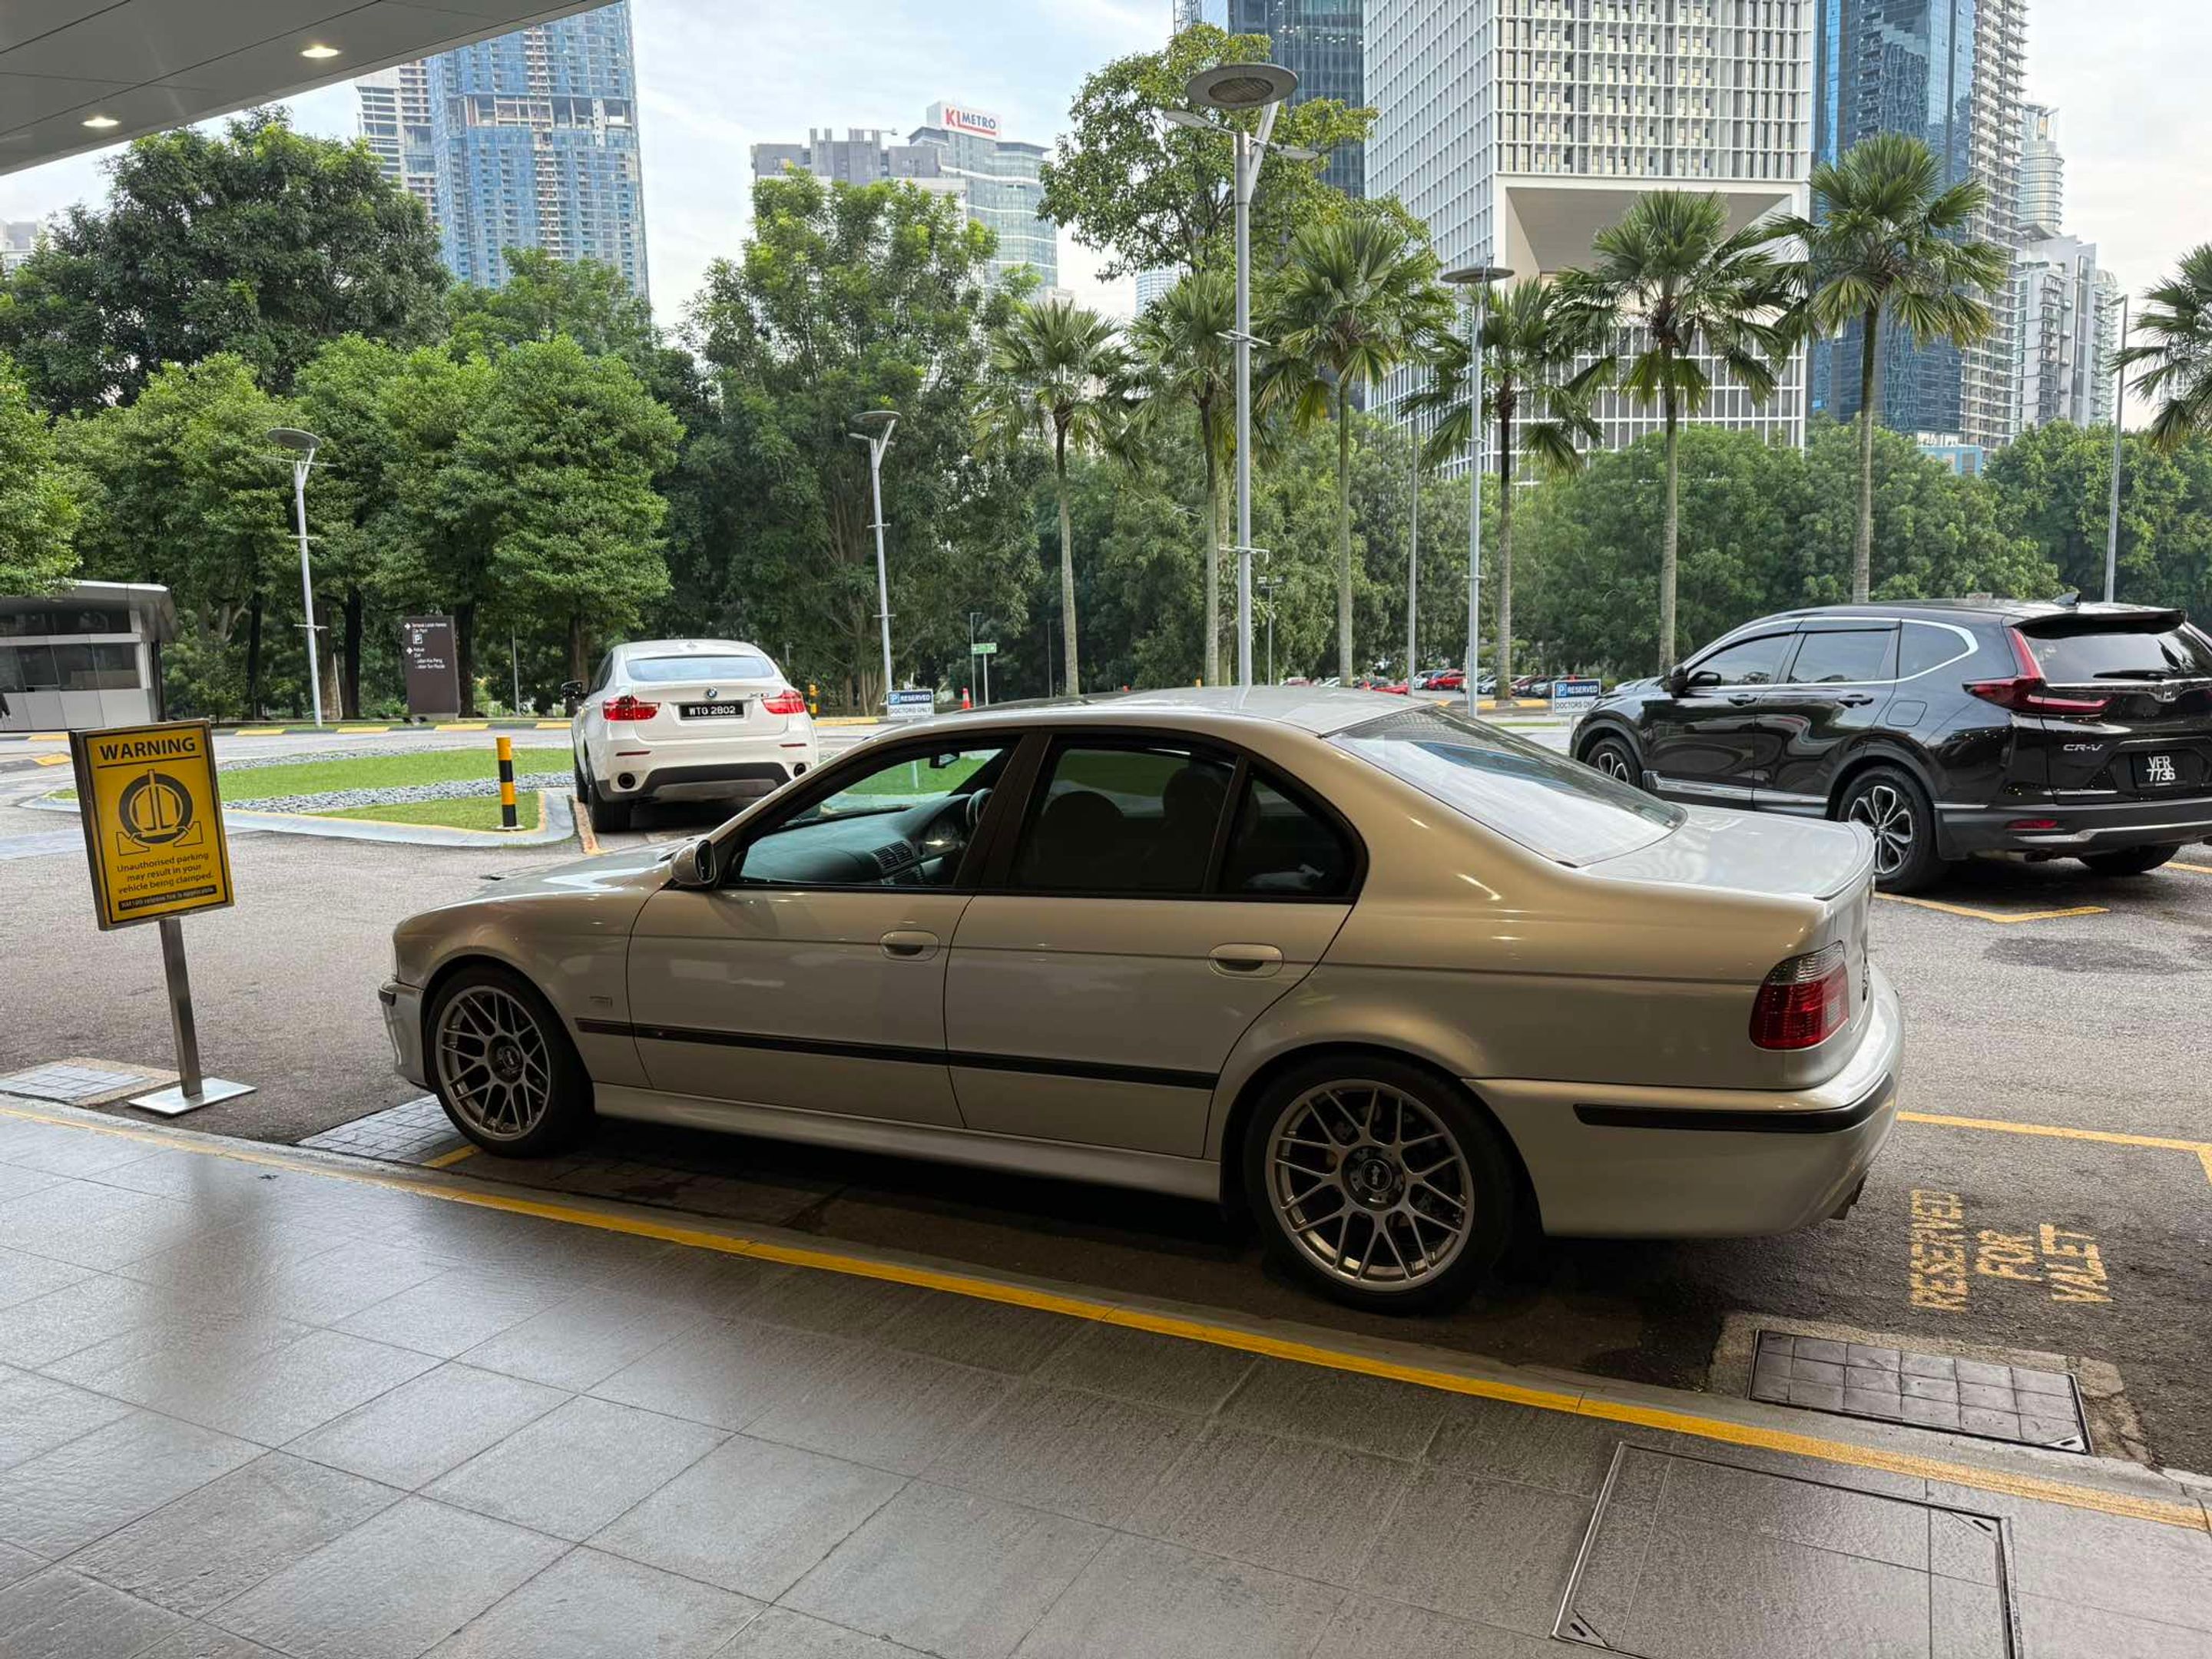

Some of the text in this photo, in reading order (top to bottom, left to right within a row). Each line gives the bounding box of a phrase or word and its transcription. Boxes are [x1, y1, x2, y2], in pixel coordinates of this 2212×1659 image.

[962, 111, 996, 129] METRO
[1567, 685, 1598, 694] RESERVED
[710, 705, 736, 715] 2802
[1556, 700, 1582, 709] DOCTORS
[99, 737, 196, 761] WARNING
[2063, 743, 2104, 752] CR-V
[2147, 756, 2171, 769] VFR
[2146, 768, 2176, 782] 7736
[117, 853, 209, 873] Unauthorised parking
[127, 873, 146, 882] may
[147, 868, 171, 878] result
[183, 864, 201, 874] your
[119, 883, 148, 894] vehicle
[150, 879, 174, 888] being
[1909, 1189, 1967, 1311] RESERVED
[1975, 1229, 2042, 1282] FOR
[2039, 1224, 2112, 1302] VALET
